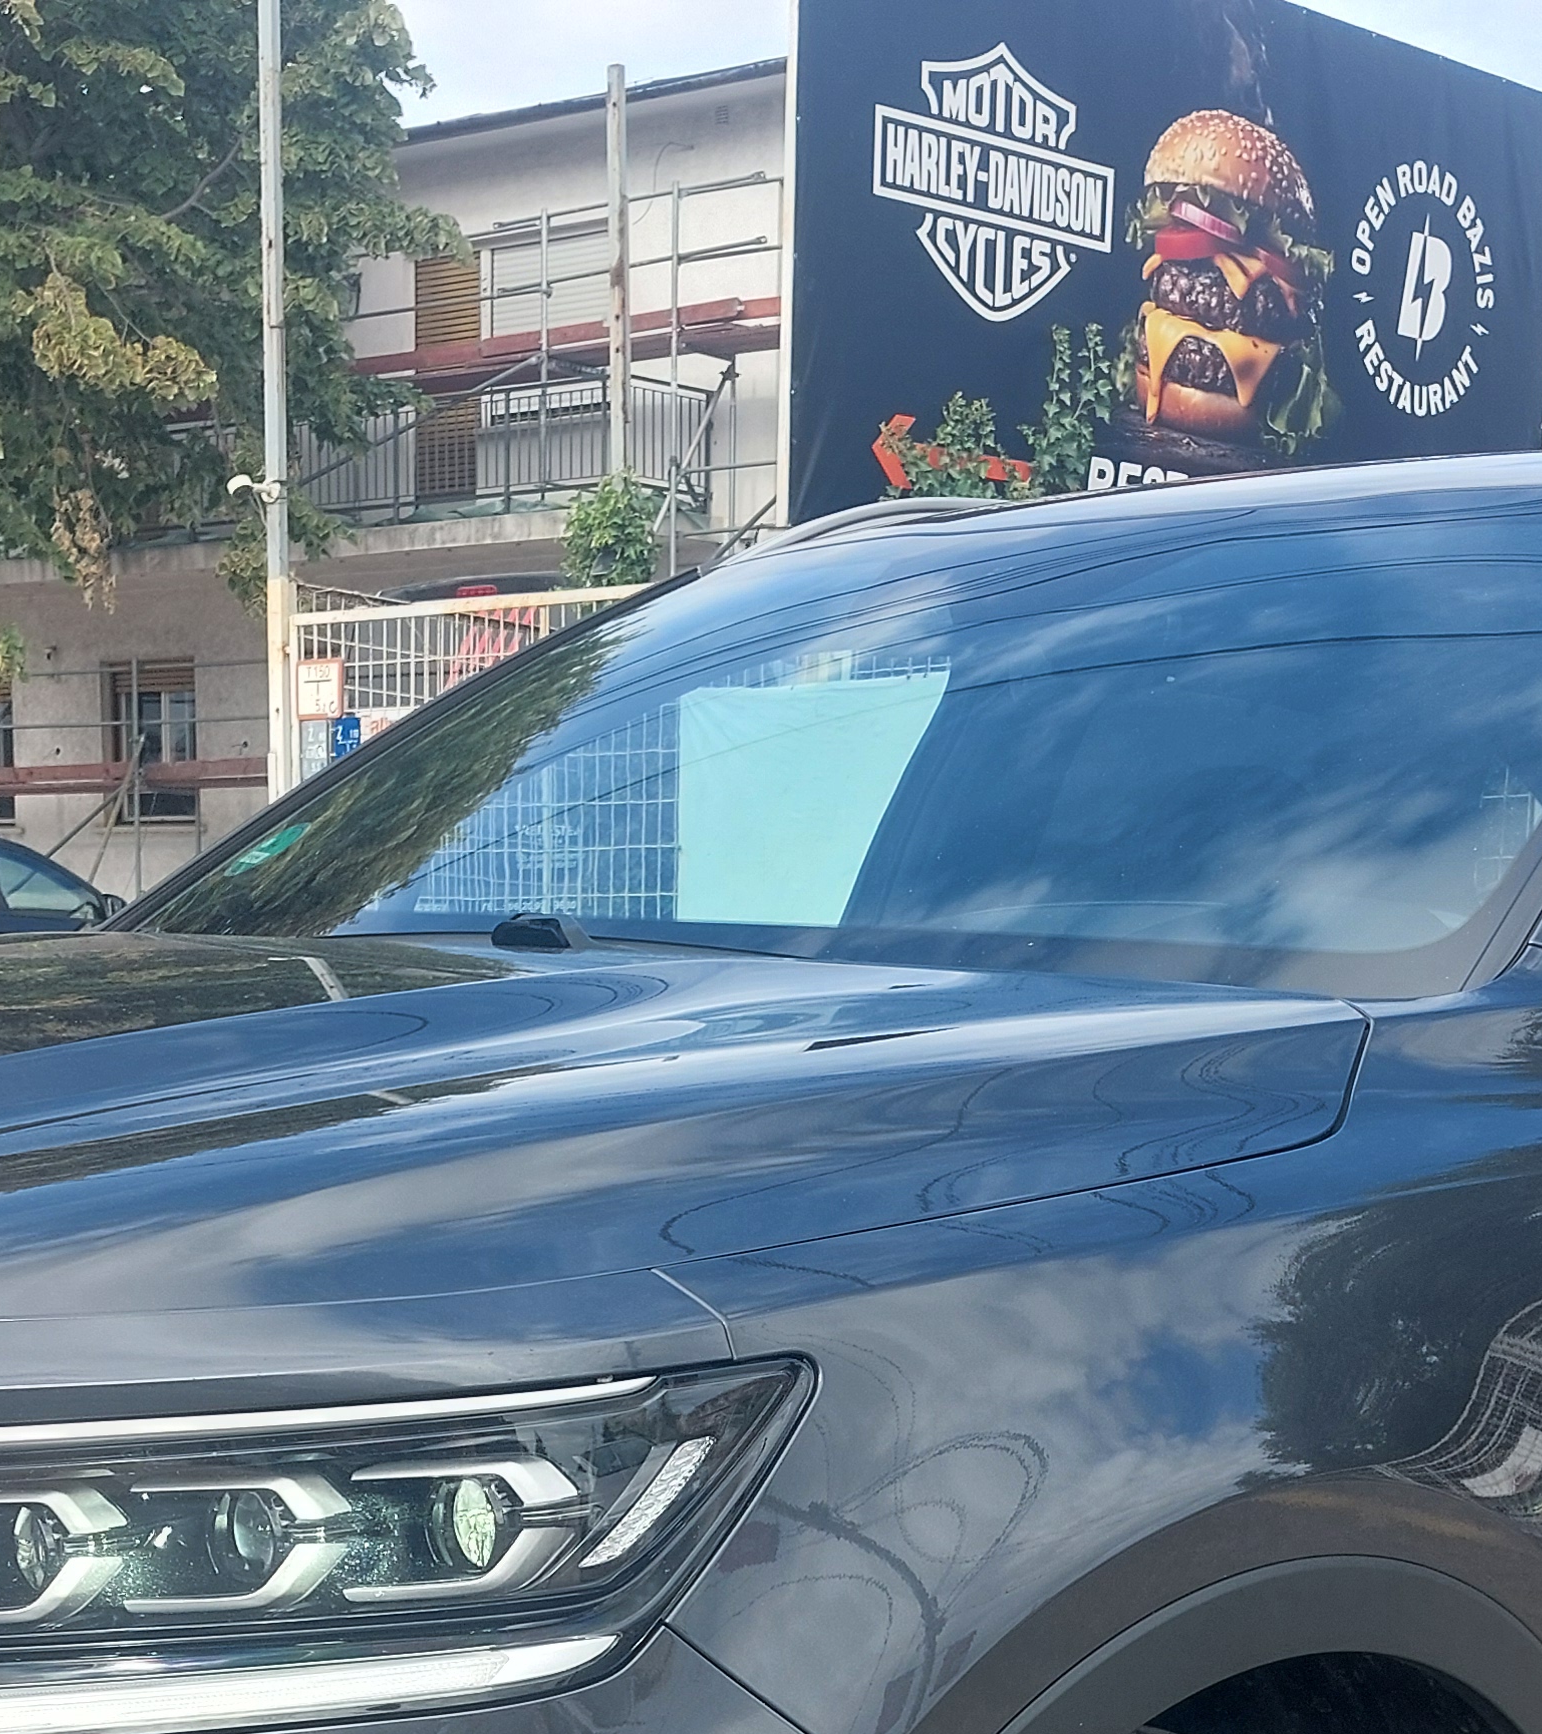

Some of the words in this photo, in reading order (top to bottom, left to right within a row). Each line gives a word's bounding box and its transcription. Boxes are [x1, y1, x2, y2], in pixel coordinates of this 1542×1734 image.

[942, 62, 1058, 147] MOTOR
[885, 122, 1104, 236] HARLEY-DAVIDSON
[935, 215, 1052, 309] CYCLES
[1351, 176, 1397, 276] OPEN
[1396, 159, 1458, 207] ROAD
[1455, 194, 1495, 310] BAZIS
[1355, 317, 1480, 417] RESTAURANT
